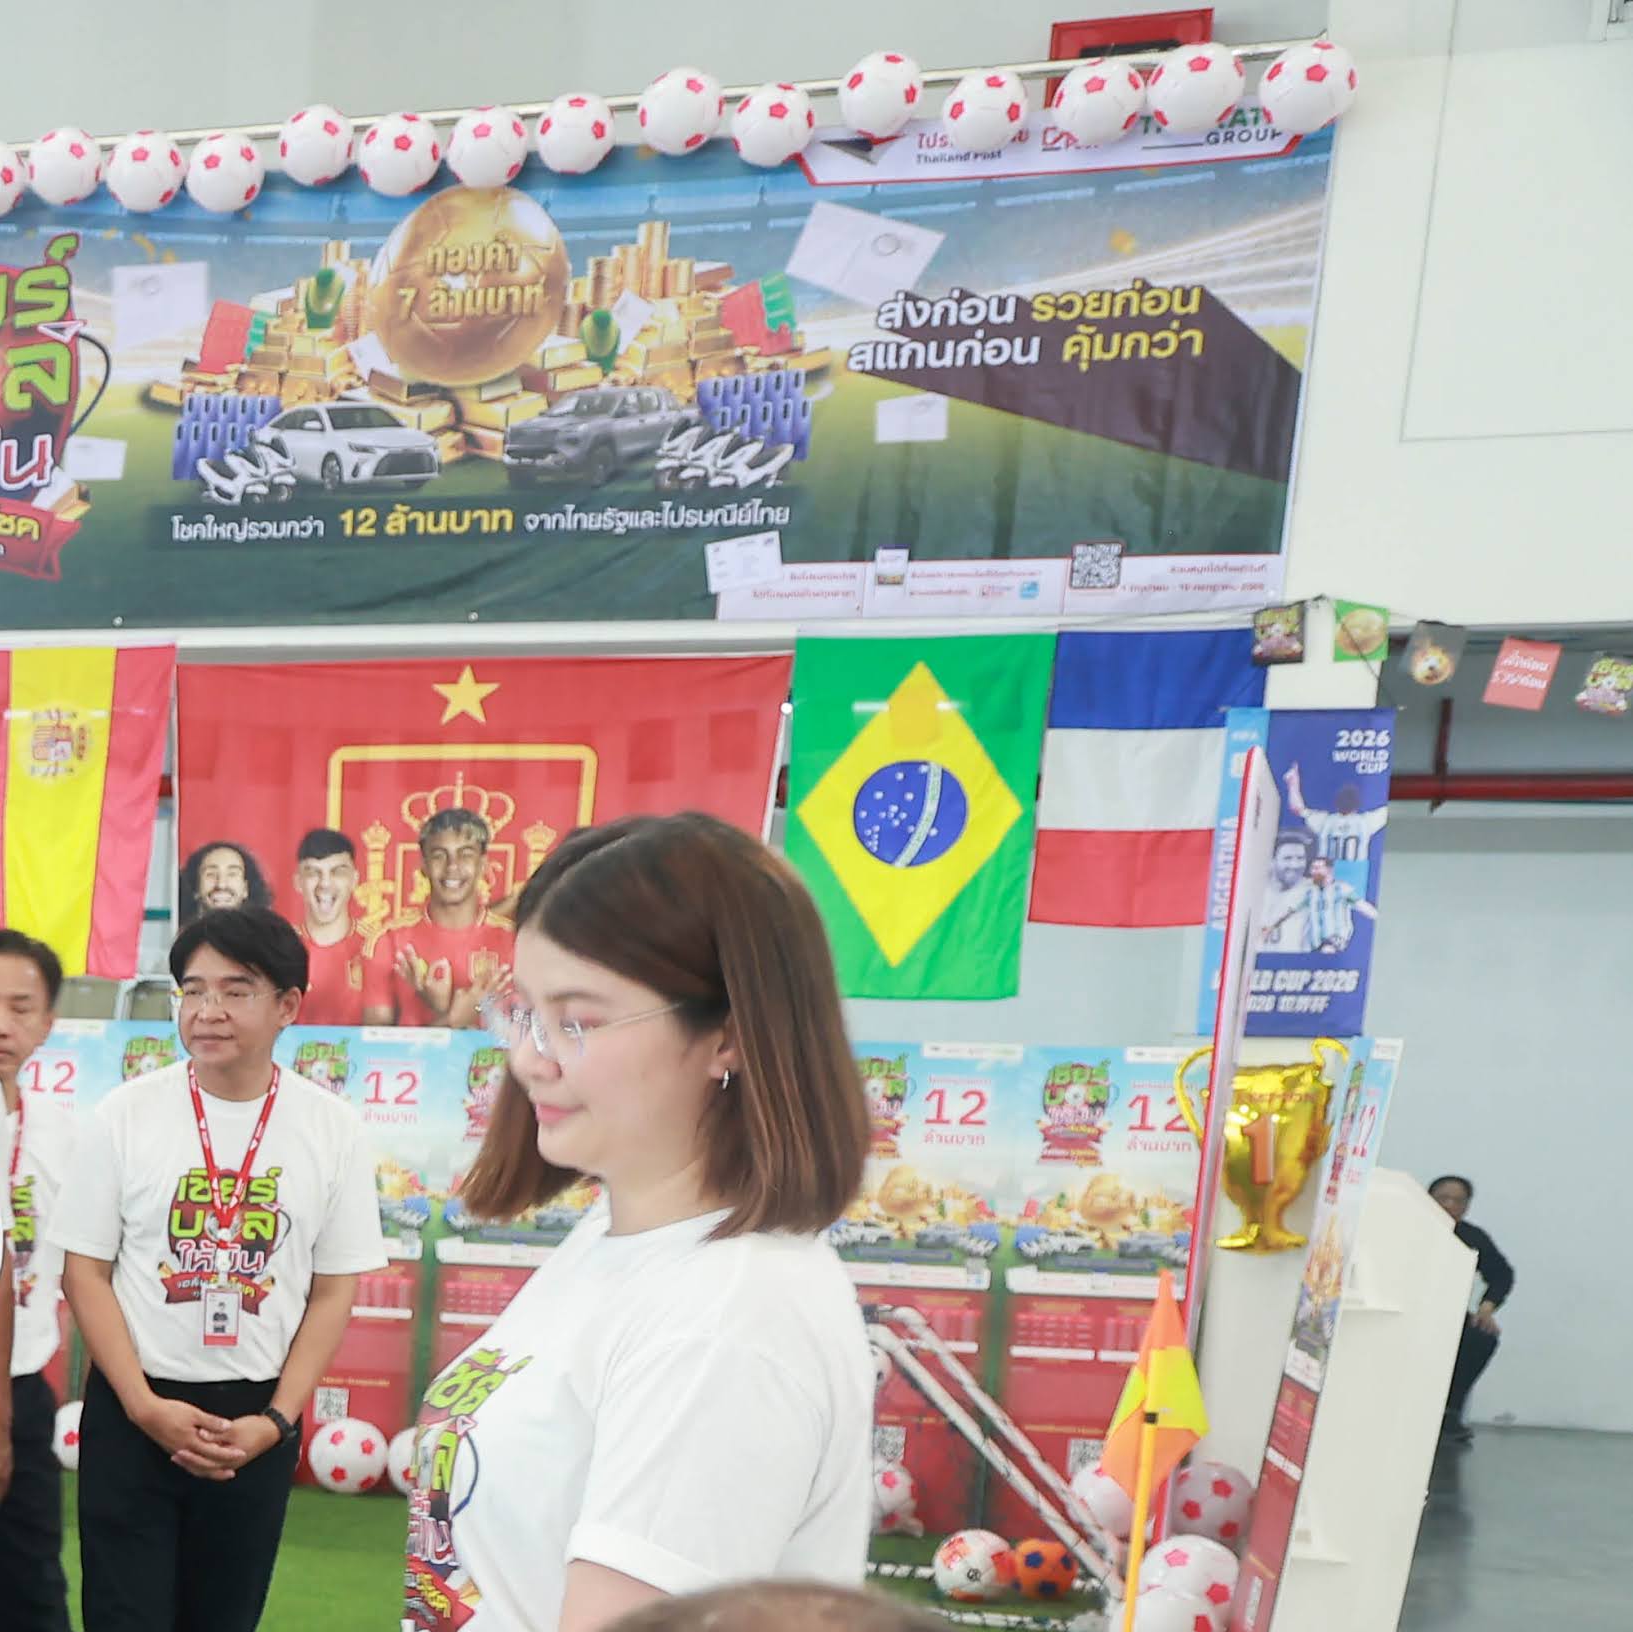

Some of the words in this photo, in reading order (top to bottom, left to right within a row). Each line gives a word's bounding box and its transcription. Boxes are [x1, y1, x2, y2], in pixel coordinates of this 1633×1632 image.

[425, 230, 522, 276] ทองคำ
[397, 287, 418, 321] 7
[429, 277, 549, 319] ล้านบาท
[877, 288, 1017, 330] ส่งก่อน
[1030, 278, 1203, 323] รวยก่อน
[846, 329, 1041, 373] สแกนก่อน
[1061, 320, 1205, 374] คุ้มกว่า
[170, 514, 325, 544] โชคใหญ่รวมกว่า
[339, 509, 378, 537] 12
[384, 505, 514, 536] ล้านบาท
[523, 498, 791, 537] จากไทยรัฐและไปรษณีย์ไทย
[1332, 749, 1390, 764] WORLD
[1335, 729, 1391, 749] 2026
[1355, 761, 1389, 775] CUP
[1273, 969, 1311, 993] CUP
[1310, 969, 1360, 993] 2026
[23, 1059, 78, 1095] 12
[363, 1069, 420, 1106] 12
[923, 1087, 990, 1126] 12
[1128, 1093, 1196, 1133] 12
[1242, 1112, 1275, 1185] 1
